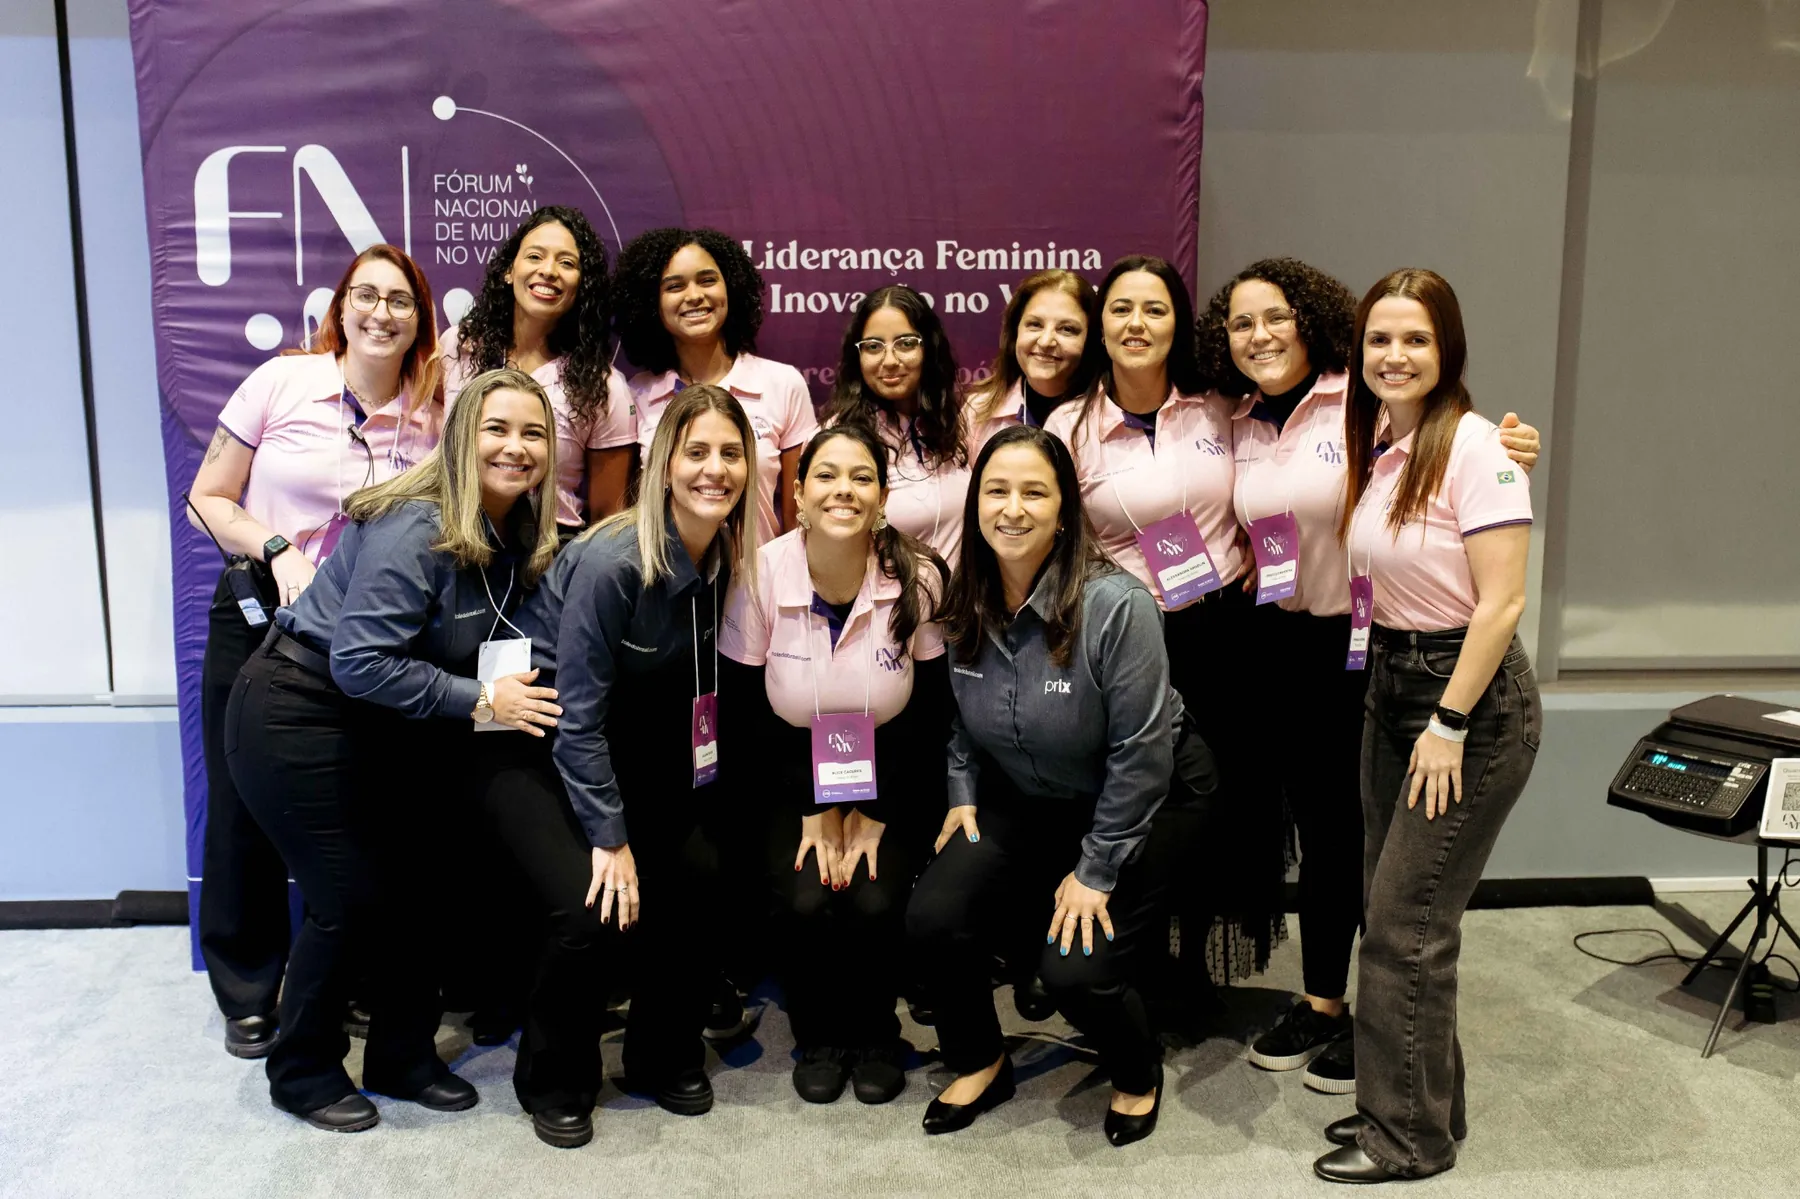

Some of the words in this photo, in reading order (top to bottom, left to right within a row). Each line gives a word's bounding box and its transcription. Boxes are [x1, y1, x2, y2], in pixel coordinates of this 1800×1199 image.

[434, 169, 512, 194] FÓRUM
[435, 222, 464, 241] DE
[436, 246, 468, 265] NO
[742, 240, 925, 276] Liderança
[936, 240, 1102, 271] Feminina
[945, 292, 989, 313] no
[1044, 678, 1071, 695] prix
